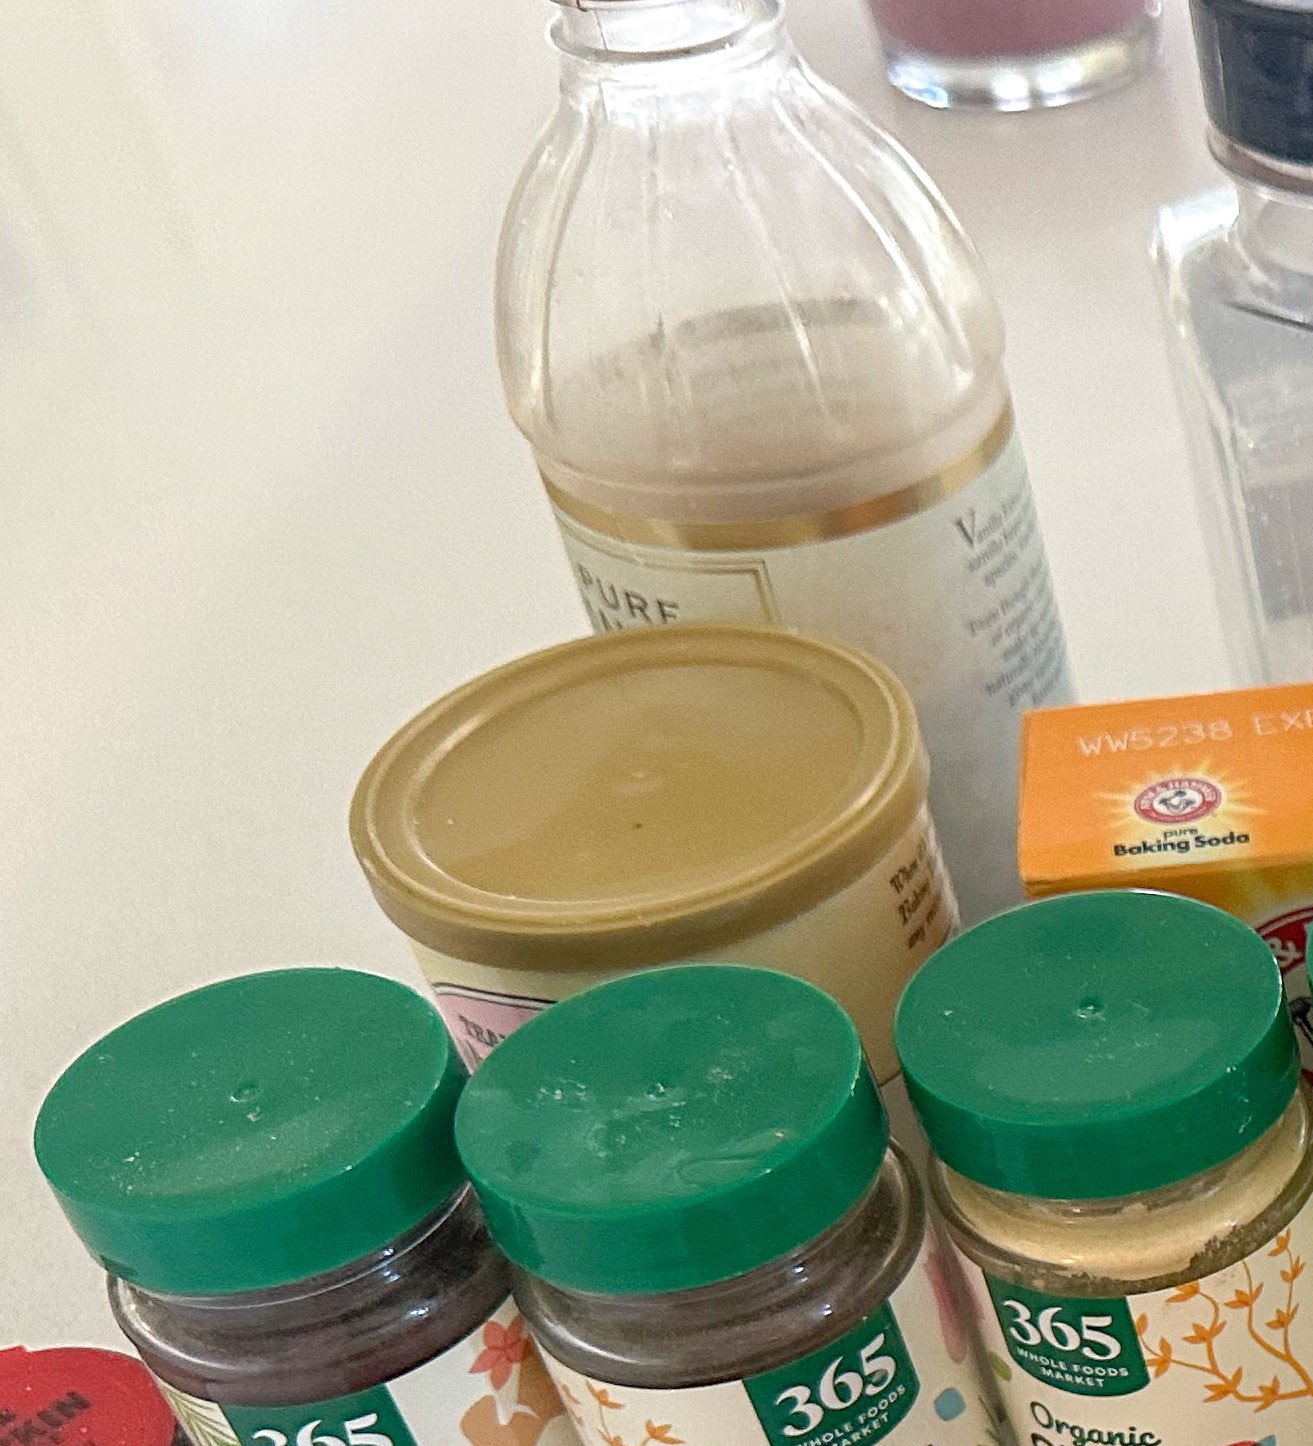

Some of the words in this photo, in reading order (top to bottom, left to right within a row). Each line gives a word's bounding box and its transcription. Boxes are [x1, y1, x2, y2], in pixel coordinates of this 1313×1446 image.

[1077, 719, 1232, 757] WW5238
[1113, 838, 1190, 857] Baking
[1195, 832, 1251, 848] Soda
[1164, 828, 1199, 840] pure
[1003, 1300, 1121, 1361] 365
[1017, 1347, 1067, 1371] WHOLE
[1073, 1364, 1129, 1377] FOODS
[1041, 1366, 1105, 1387] MARKET
[774, 1332, 897, 1438] 365
[858, 1384, 906, 1425] FOODS
